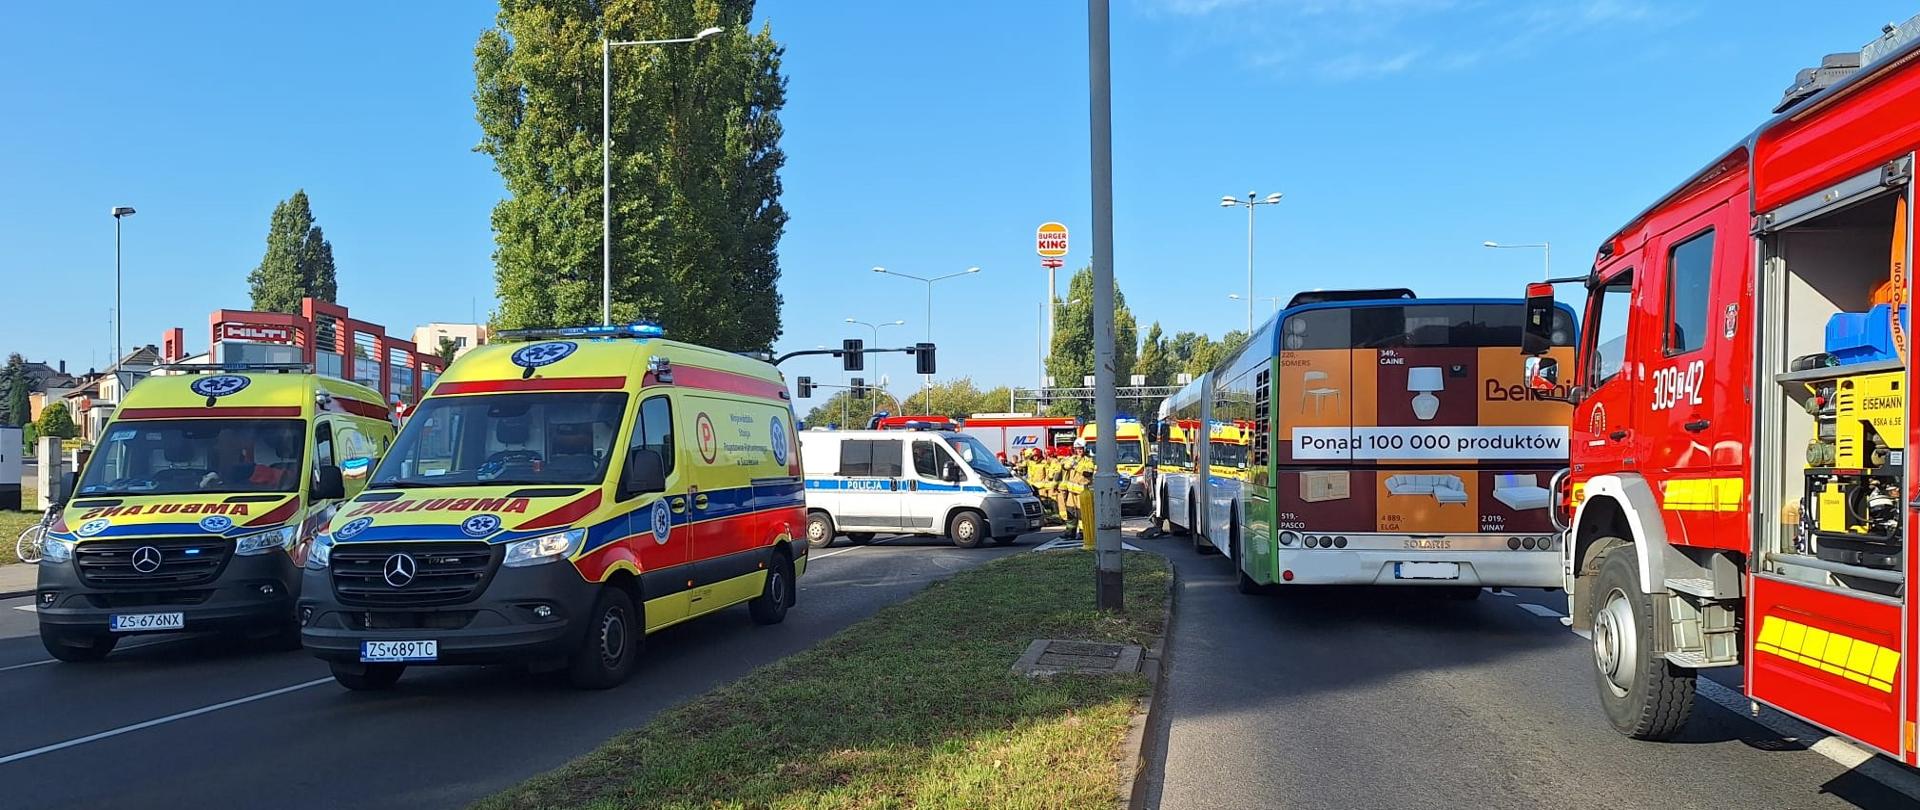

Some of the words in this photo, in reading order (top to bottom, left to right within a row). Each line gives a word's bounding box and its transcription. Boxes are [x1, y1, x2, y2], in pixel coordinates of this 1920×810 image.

[1038, 240, 1067, 249] KING
[227, 327, 287, 339] HILTI
[1862, 396, 1903, 410] EISEMANN
[701, 423, 711, 452] P
[1300, 434, 1362, 450] Ponad
[1368, 435, 1403, 449] 100
[1409, 435, 1450, 449] 000
[1457, 433, 1561, 452] produktów
[847, 480, 882, 490] POLICJA
[1280, 521, 1305, 529] PASCO
[1380, 523, 1400, 531] ELGA
[1403, 540, 1451, 549] SOLARIS
